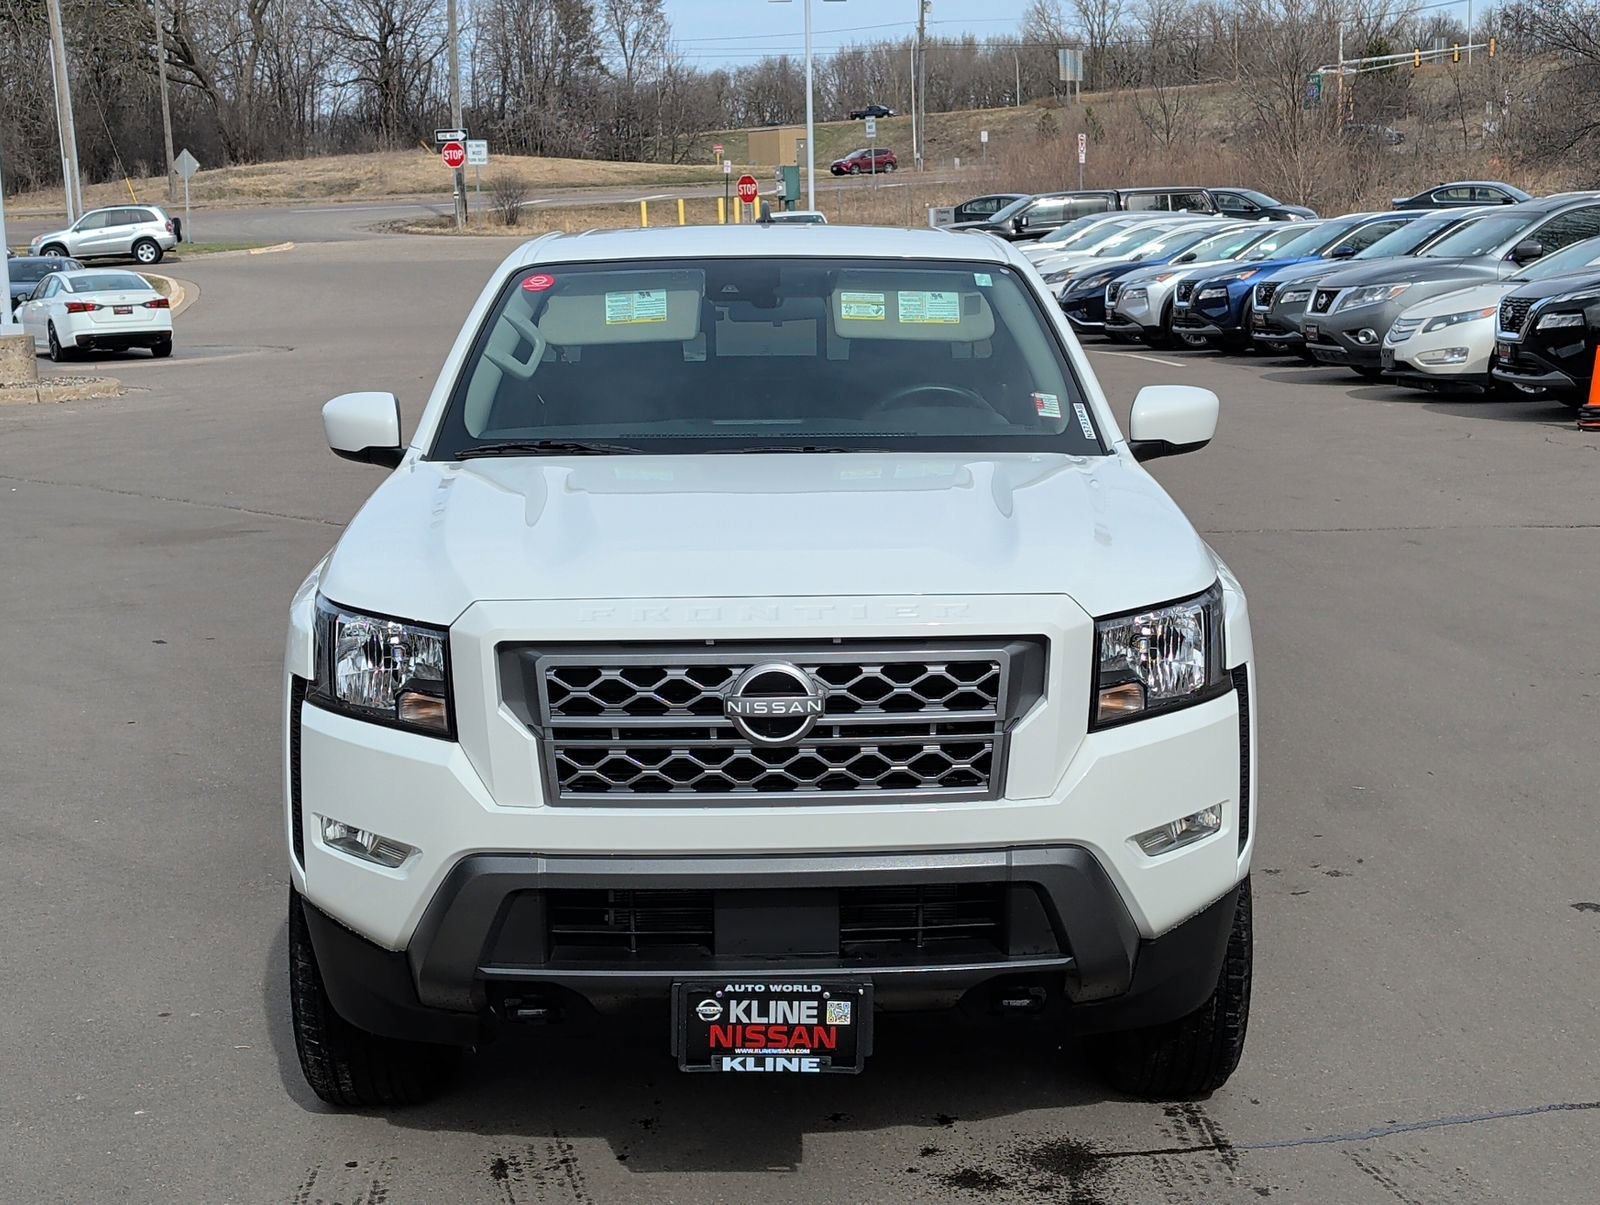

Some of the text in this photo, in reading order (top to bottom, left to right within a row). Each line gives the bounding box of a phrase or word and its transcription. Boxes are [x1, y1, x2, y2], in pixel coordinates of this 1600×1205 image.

[444, 149, 463, 160] STOP
[738, 183, 756, 195] STOP
[576, 603, 971, 623] FRONTIER
[727, 699, 821, 714] NISSAN
[724, 984, 822, 993] AUTO WORLD
[729, 1000, 818, 1024] KLINE
[709, 1025, 836, 1049] NISSAN
[722, 1056, 821, 1073] KLINE
